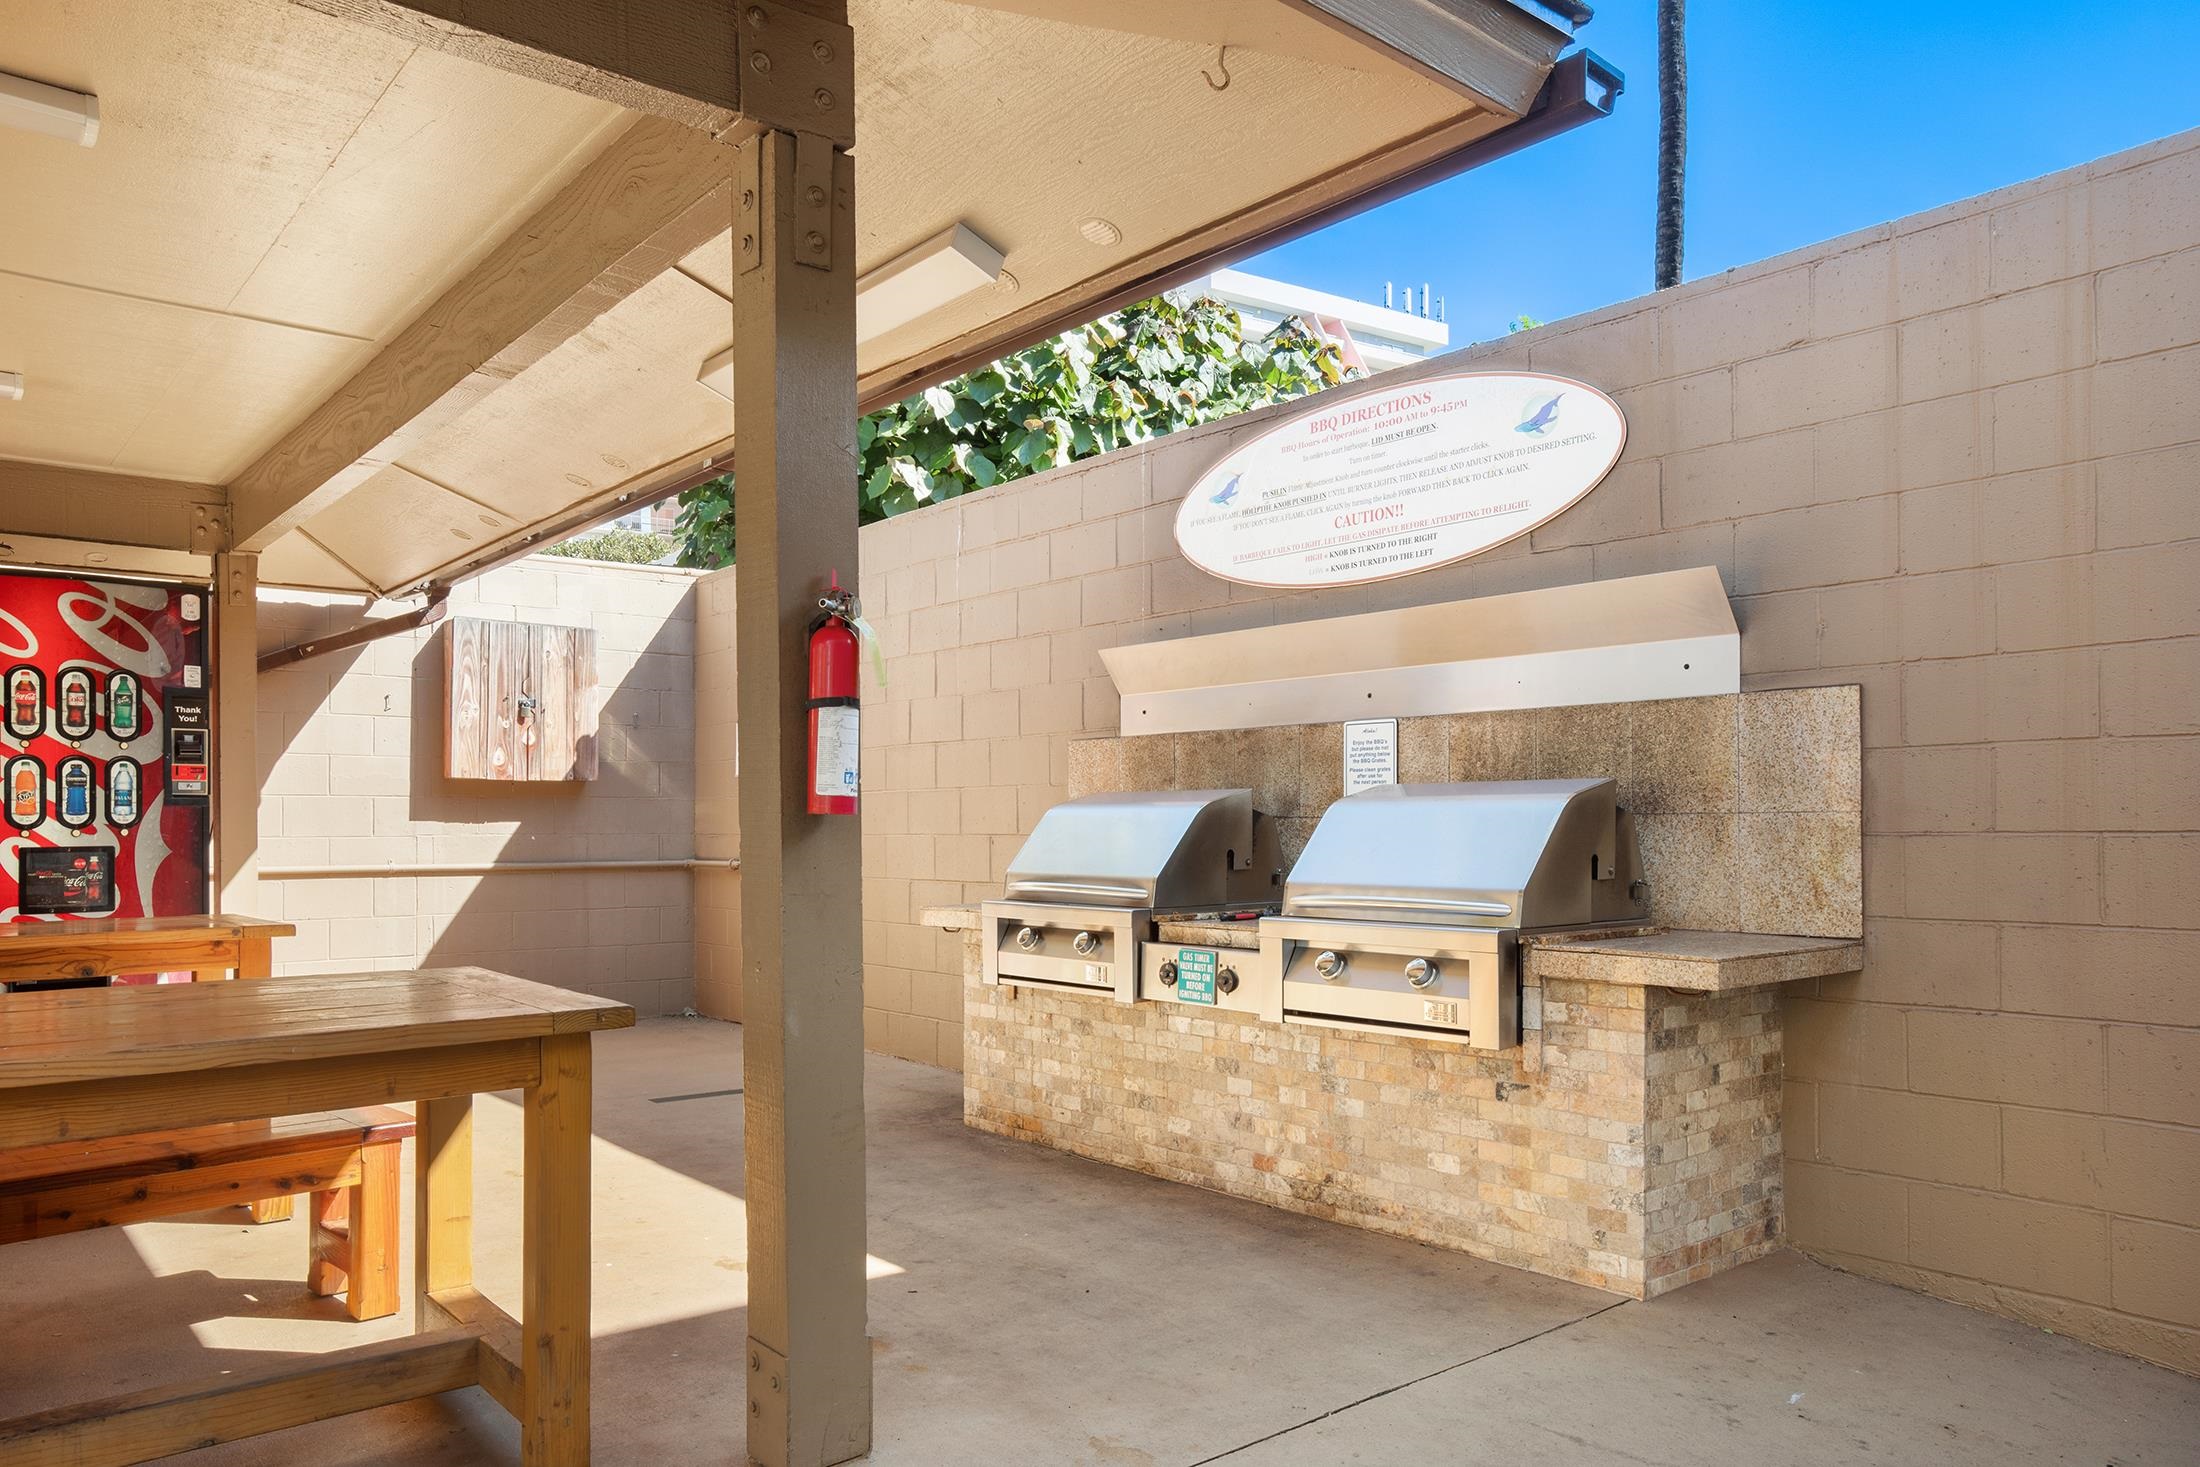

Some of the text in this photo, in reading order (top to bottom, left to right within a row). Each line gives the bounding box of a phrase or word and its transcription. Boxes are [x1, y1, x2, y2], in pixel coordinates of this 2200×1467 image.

[1310, 391, 1432, 435] BBQ DIRECTIONS
[1280, 442, 1296, 454] BBQ
[1298, 436, 1320, 448] Hours
[1321, 434, 1329, 442] of
[1330, 424, 1370, 442] Operation:
[1374, 416, 1402, 430] 10:00
[1404, 412, 1418, 422] AM
[1420, 409, 1428, 418] to
[1370, 435, 1383, 446] LID
[1384, 430, 1403, 442] MUST
[1405, 428, 1414, 437] BE
[1416, 422, 1438, 434] OPEN.
[1262, 488, 1278, 498] PUSH
[1279, 486, 1286, 494] IN
[1350, 469, 1361, 479] and
[1374, 462, 1395, 473] counter
[1396, 456, 1423, 468] clockwise
[1424, 452, 1438, 462] until
[1439, 450, 1449, 459] the
[1450, 445, 1470, 456] starter
[1273, 498, 1292, 508] KNOB
[1292, 492, 1318, 504] PUSHED
[1319, 491, 1326, 499] IN
[1328, 487, 1346, 497] UNTIL
[1347, 481, 1372, 492] BURNER
[1400, 471, 1417, 481] THEN
[1418, 465, 1447, 477] RELEASE
[1449, 461, 1464, 471] AND
[1466, 455, 1492, 467] ADJUST
[1494, 450, 1514, 461] KNOB
[1516, 448, 1526, 456] TO
[1527, 440, 1560, 454] DESIRED
[1561, 432, 1598, 447] SETTING.
[1325, 501, 1343, 511] AGAIN
[1372, 493, 1382, 501] the
[1382, 490, 1397, 499] knob
[1398, 483, 1430, 496] FORWARD
[1432, 479, 1450, 489] THEN
[1452, 475, 1470, 485] BACK
[1472, 473, 1481, 481] TO
[1482, 468, 1503, 479] CLICK
[1292, 542, 1300, 550] TO
[1324, 536, 1336, 544] LET
[1338, 533, 1350, 541] THE
[1352, 530, 1366, 539] GAS
[1366, 524, 1400, 536] DISIPATE
[1400, 519, 1428, 530] BEFORE
[1430, 510, 1480, 525] ATTEMPTING
[1492, 500, 1532, 513] RELIGHT.
[1334, 504, 1404, 528] CAUTION!!
[1304, 553, 1322, 562] HIGH
[1328, 548, 1348, 558] KNOB
[1357, 542, 1386, 553] TURNED
[1386, 540, 1397, 548] TO
[1398, 537, 1412, 546] THE
[1414, 532, 1438, 543] RIGHT
[1330, 562, 1349, 572] KNOB
[1358, 556, 1387, 567] TURNED
[1388, 554, 1398, 562] TO
[1399, 551, 1414, 560] THE
[1415, 547, 1434, 557] LEFT
[174, 706, 201, 714] Thank
[1180, 961, 1213, 973] VALVE MUST BE
[1182, 952, 1210, 963] GAS TIMER
[1181, 971, 1211, 982] TURNED ON
[1186, 981, 1205, 991] BEFORE
[1179, 990, 1212, 1002] IGNITING BBQ
